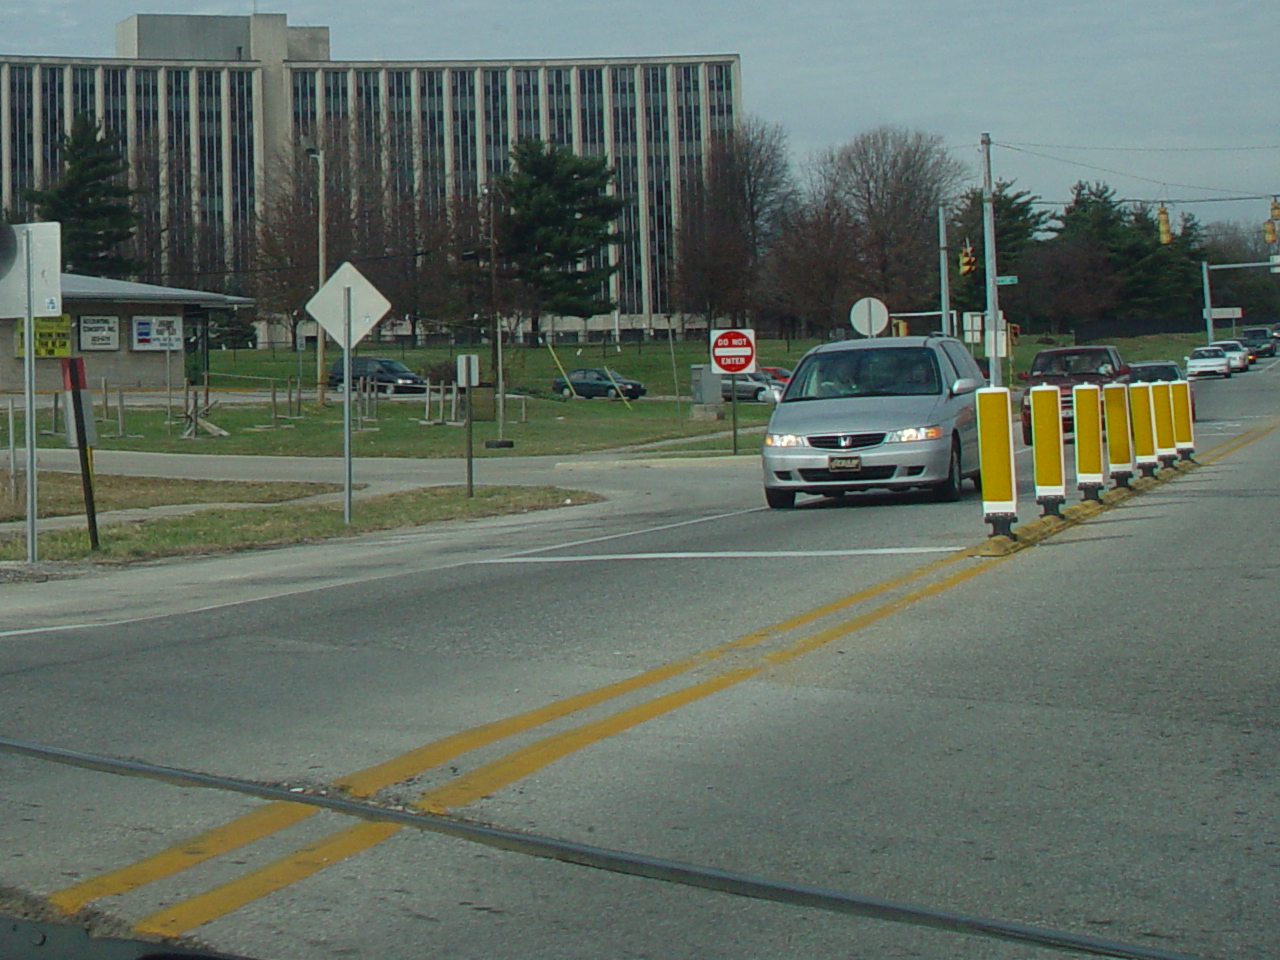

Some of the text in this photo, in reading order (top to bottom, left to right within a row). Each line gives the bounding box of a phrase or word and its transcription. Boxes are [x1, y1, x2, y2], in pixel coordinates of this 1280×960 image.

[717, 338, 747, 346] DO NOT
[721, 357, 745, 365] ENTER
